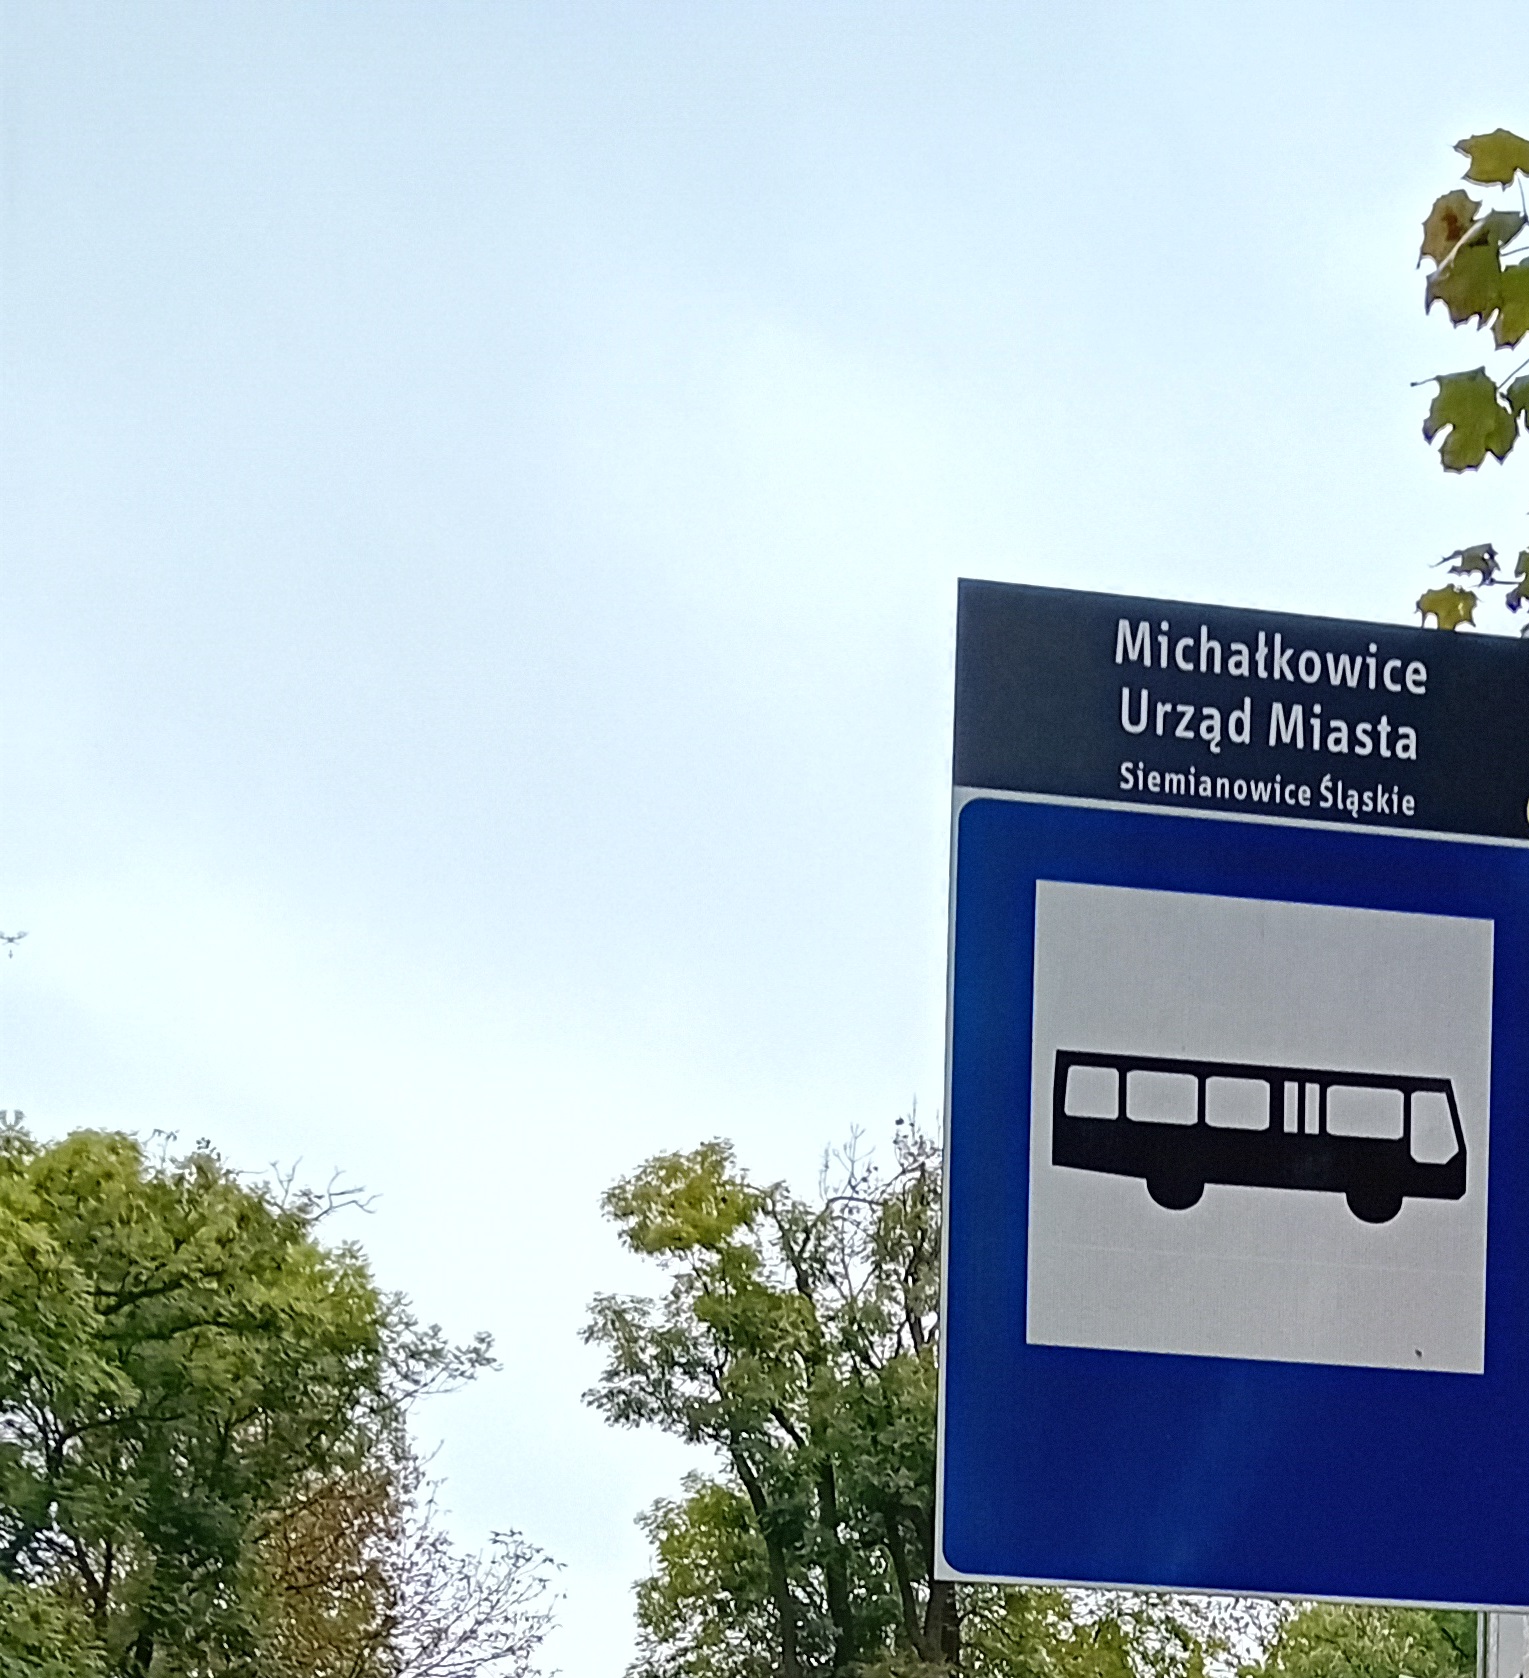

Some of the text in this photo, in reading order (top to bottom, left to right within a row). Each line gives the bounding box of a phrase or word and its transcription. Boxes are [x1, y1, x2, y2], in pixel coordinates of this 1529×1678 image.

[1115, 618, 1428, 695] Michałkowice
[1121, 686, 1418, 760] Urząd Miasta
[1119, 761, 1416, 818] Siemianowice Śląskie
